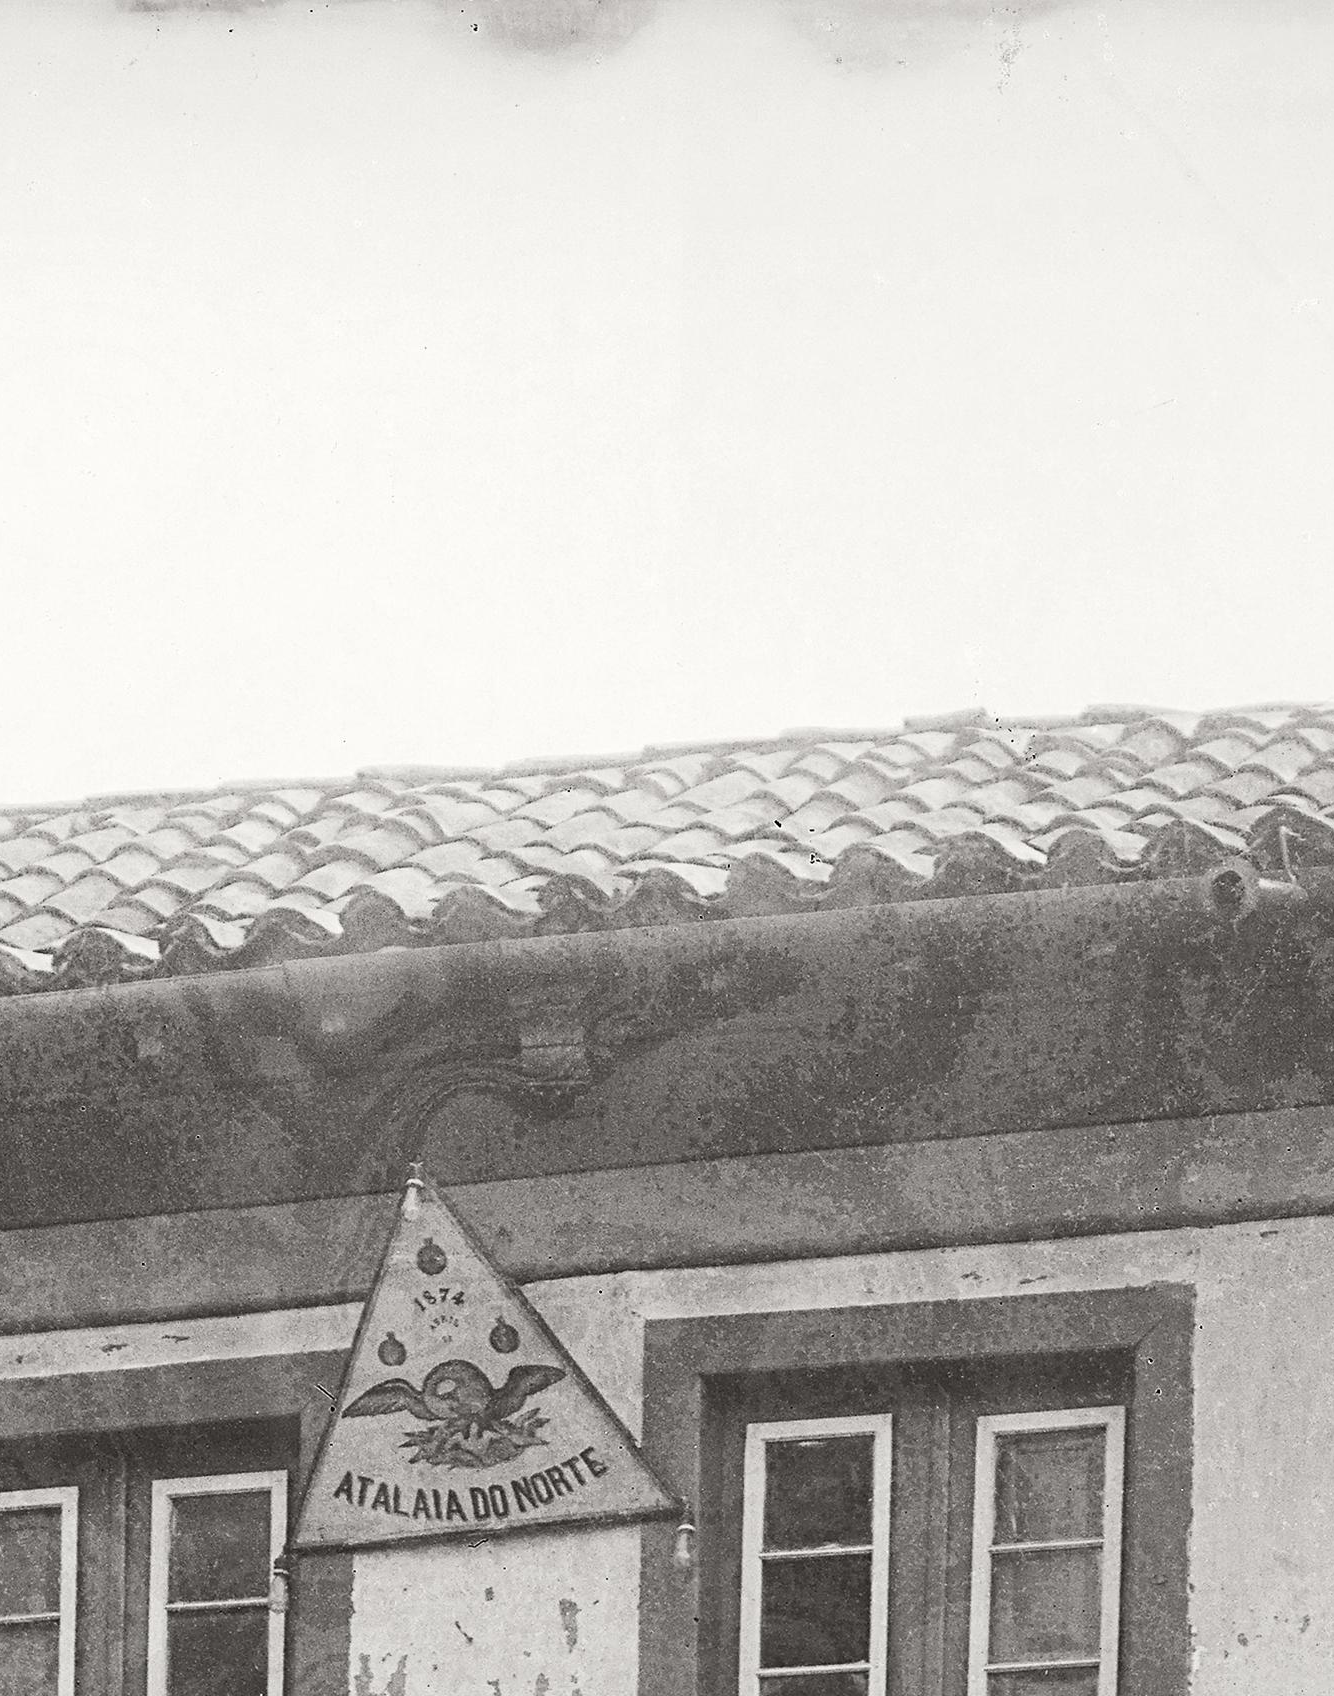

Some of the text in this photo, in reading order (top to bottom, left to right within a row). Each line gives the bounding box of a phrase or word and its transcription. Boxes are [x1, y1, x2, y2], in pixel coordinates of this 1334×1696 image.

[414, 1287, 466, 1313] 1874
[334, 1446, 609, 1523] ATALAIA DO NORTE
